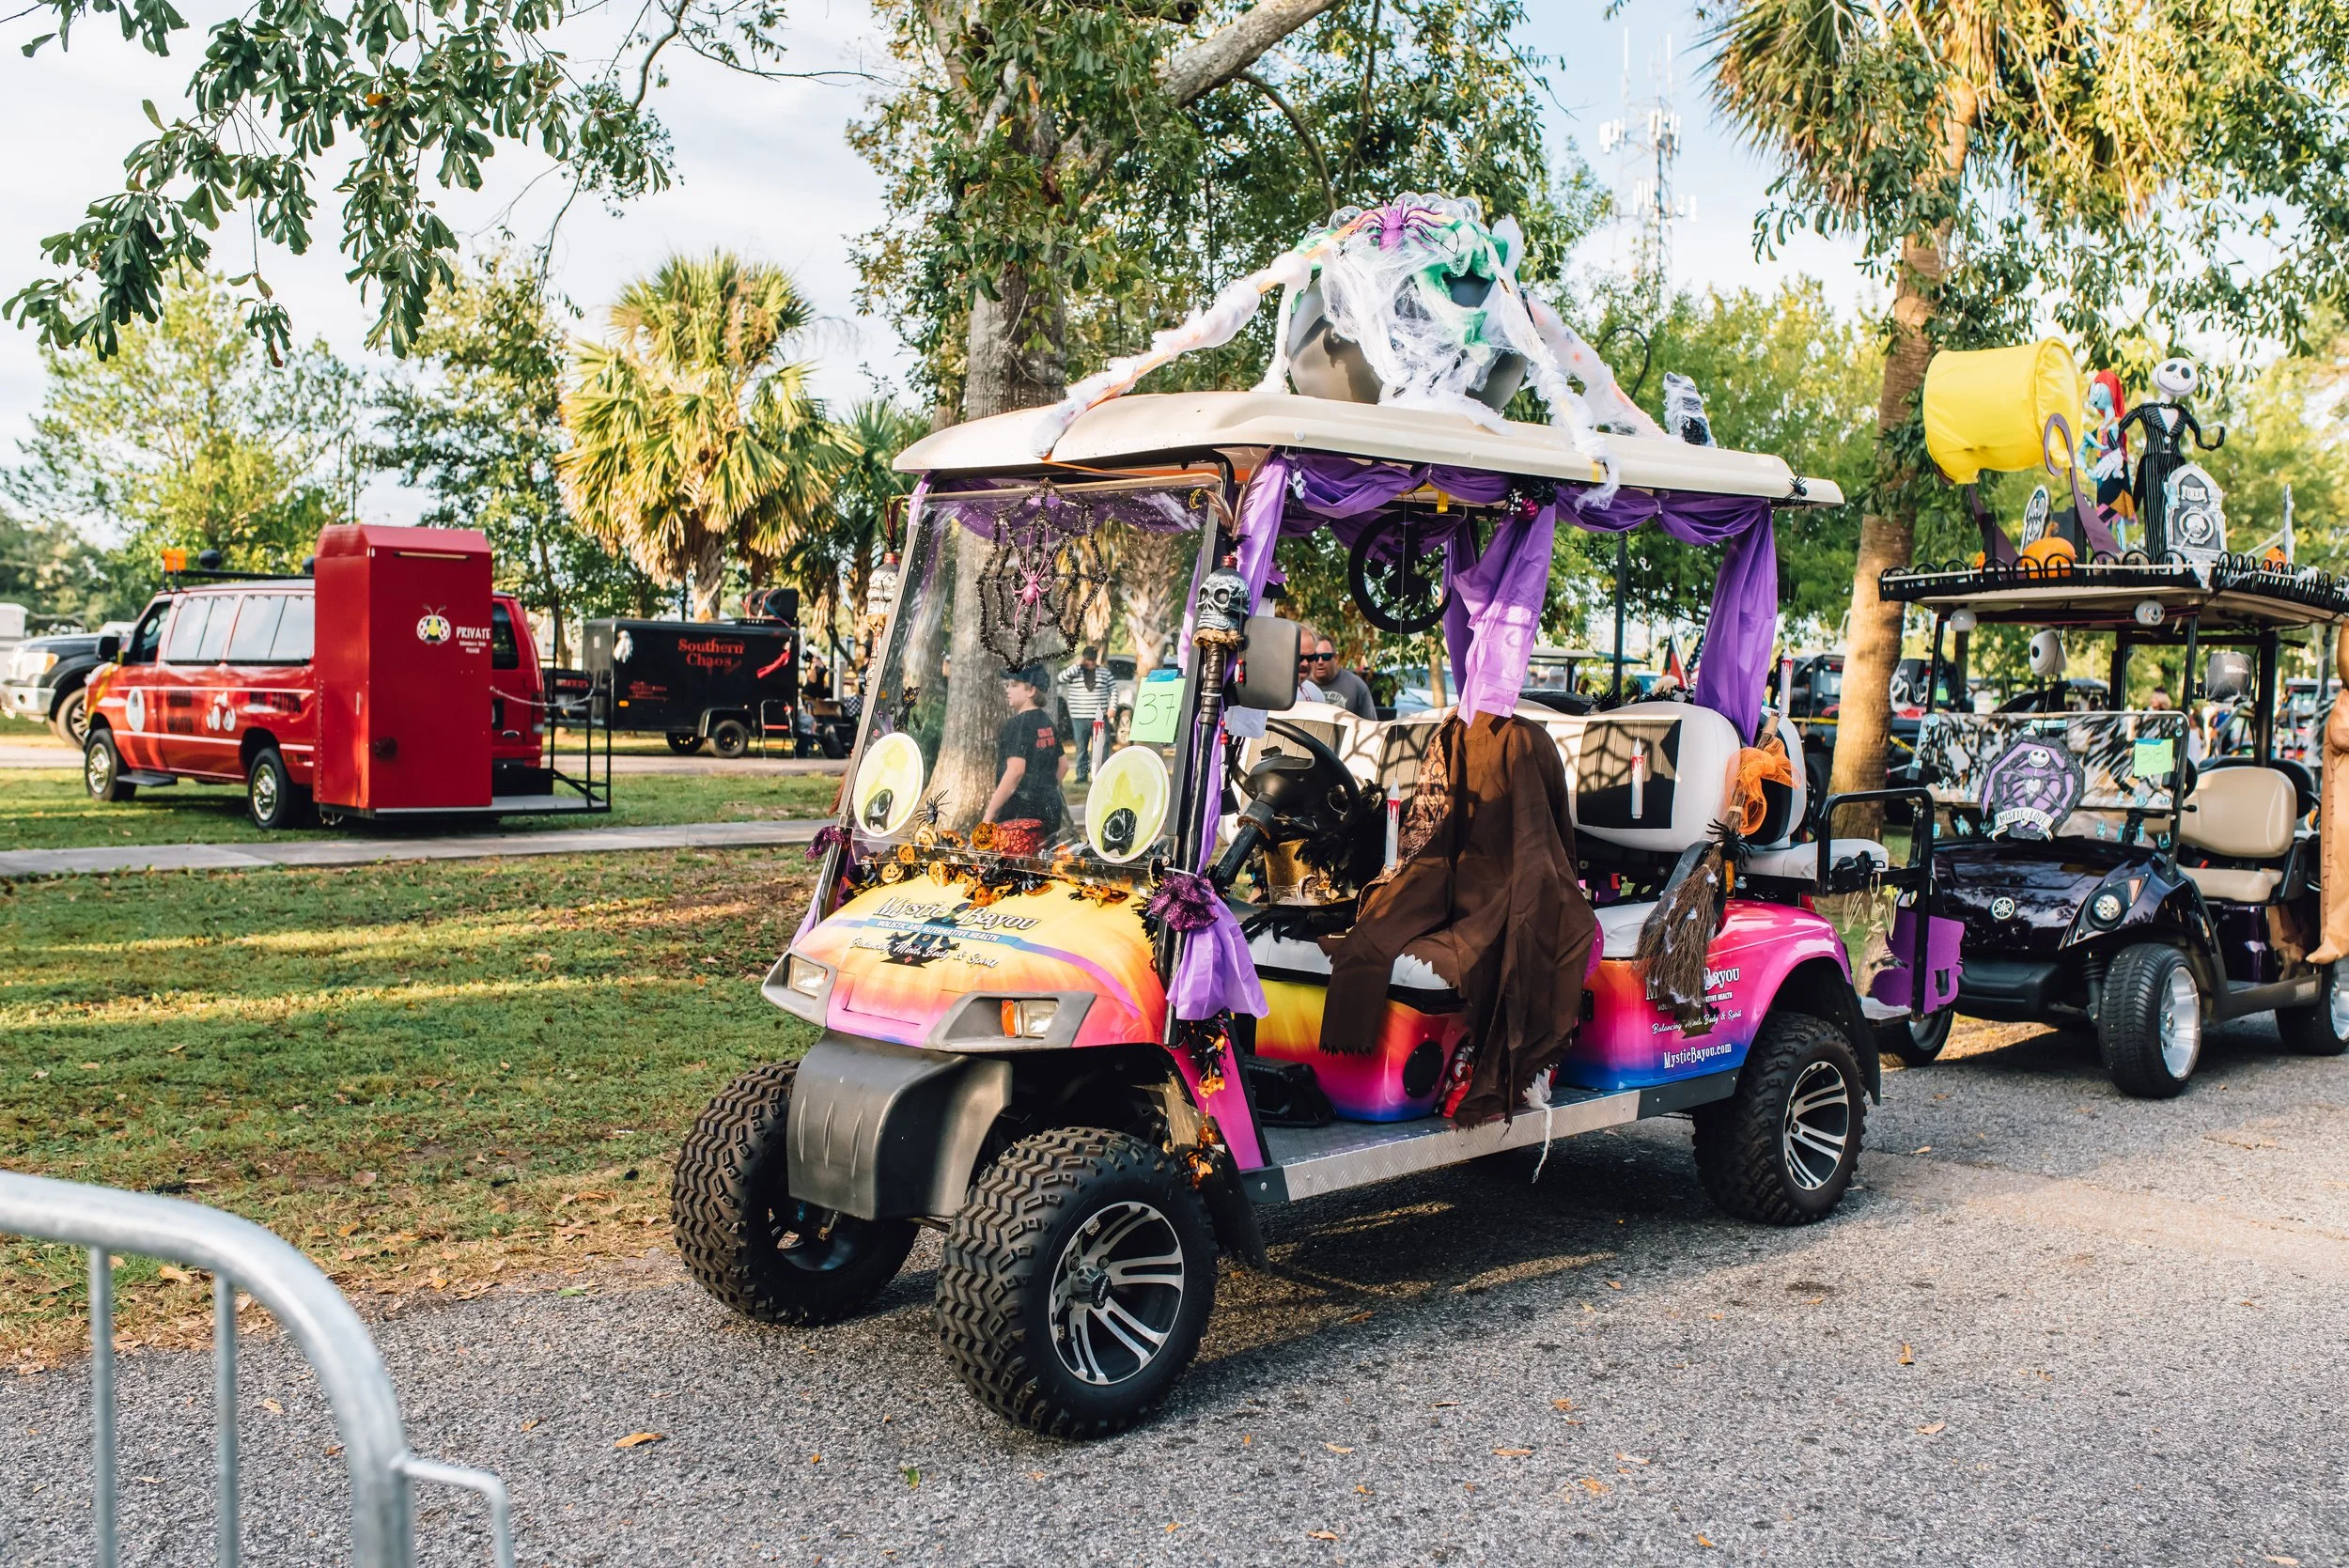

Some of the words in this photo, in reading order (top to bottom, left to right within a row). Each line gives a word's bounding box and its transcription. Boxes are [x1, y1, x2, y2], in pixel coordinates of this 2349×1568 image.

[456, 626, 490, 639] PRIVATE
[678, 637, 744, 654] Southern
[686, 652, 732, 666] Chaos
[1138, 693, 1175, 726] 37
[1999, 810, 2023, 823] MISFIT
[2030, 811, 2047, 824] LOVE
[873, 896, 949, 918] Mystic
[955, 907, 1042, 930] Bayou
[876, 920, 908, 931] HOLISTIC
[907, 923, 923, 933] AND
[921, 924, 970, 938] ALTERNATIVE
[967, 930, 1001, 942] HEALTH
[922, 945, 951, 963] Body
[954, 949, 966, 961] &
[967, 951, 1001, 968] Spirit
[1703, 967, 1740, 990] Bayou
[1717, 992, 1733, 1001] HEALTH
[1651, 1022, 1682, 1034] Balancing
[1703, 1014, 1719, 1026] Body
[1720, 1012, 1727, 1020] &
[1728, 1009, 1742, 1022] Spirit
[1663, 1043, 1732, 1069] MysticBayou.com
